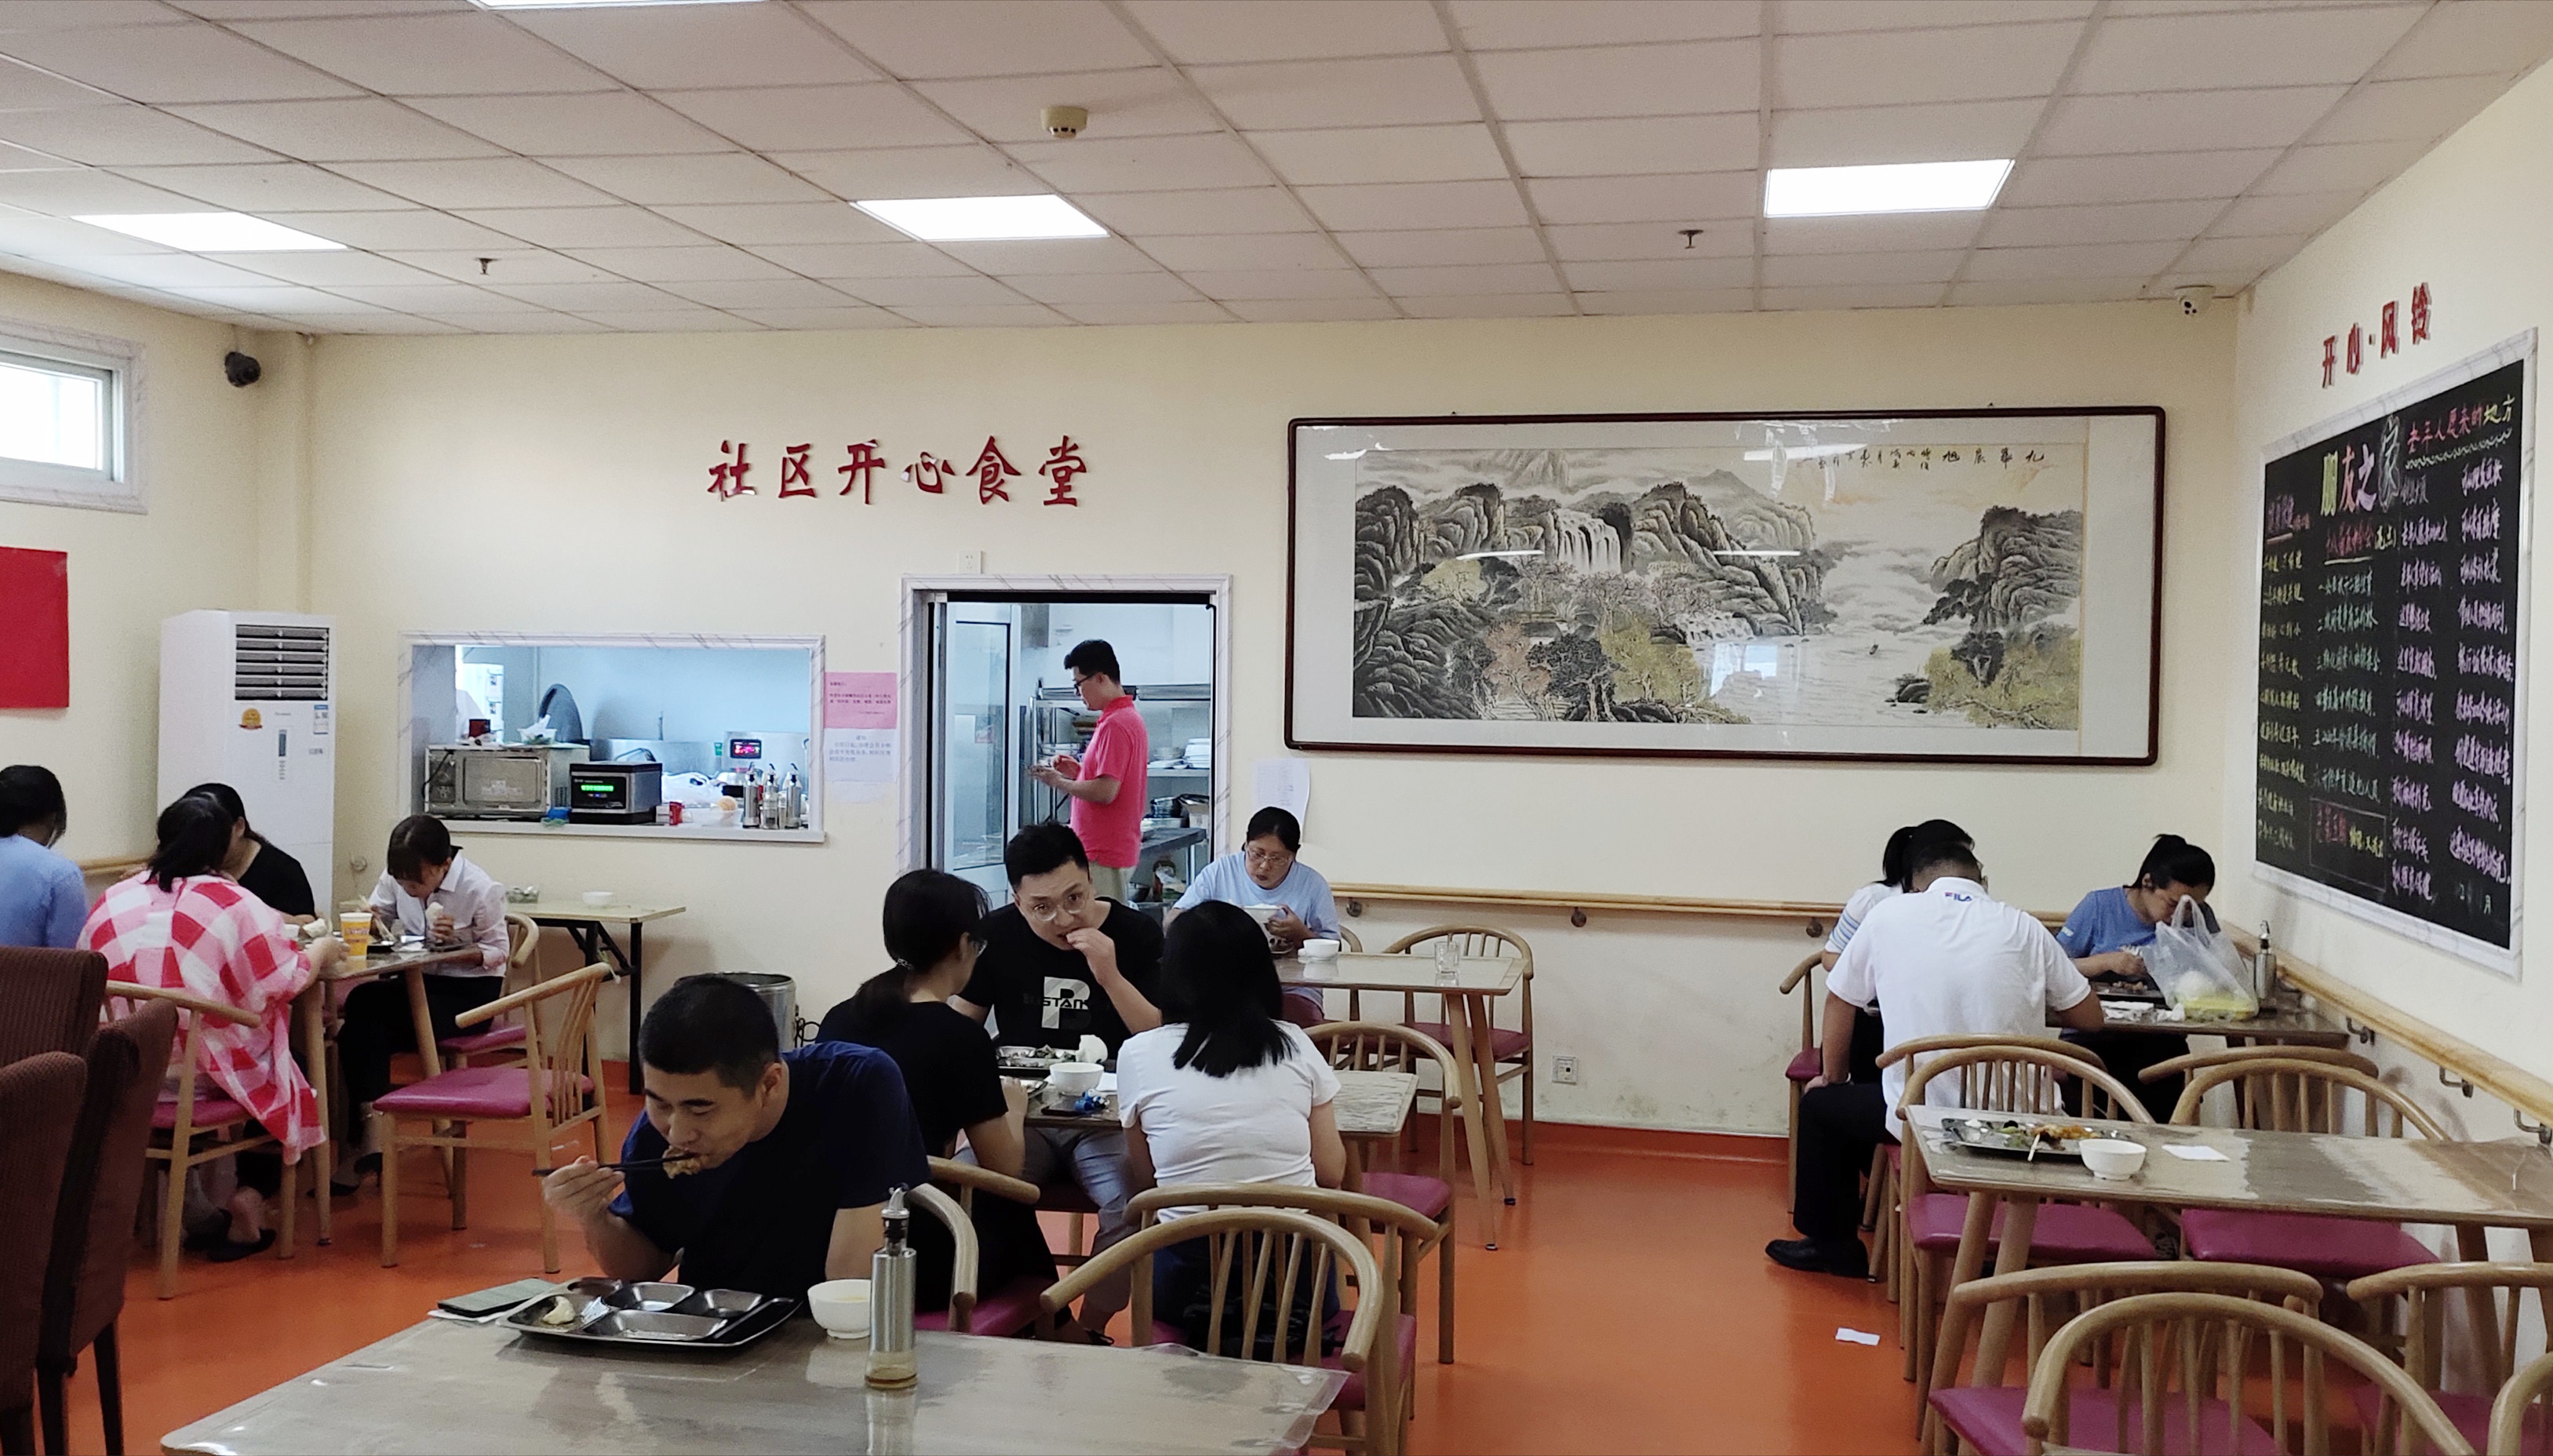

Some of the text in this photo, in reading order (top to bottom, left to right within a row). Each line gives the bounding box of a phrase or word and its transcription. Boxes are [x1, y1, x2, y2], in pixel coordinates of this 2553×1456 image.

[707, 435, 1087, 508] 社区开心食堂
[2321, 415, 2399, 517] 朋友之家
[1945, 891, 1972, 902] FILA
